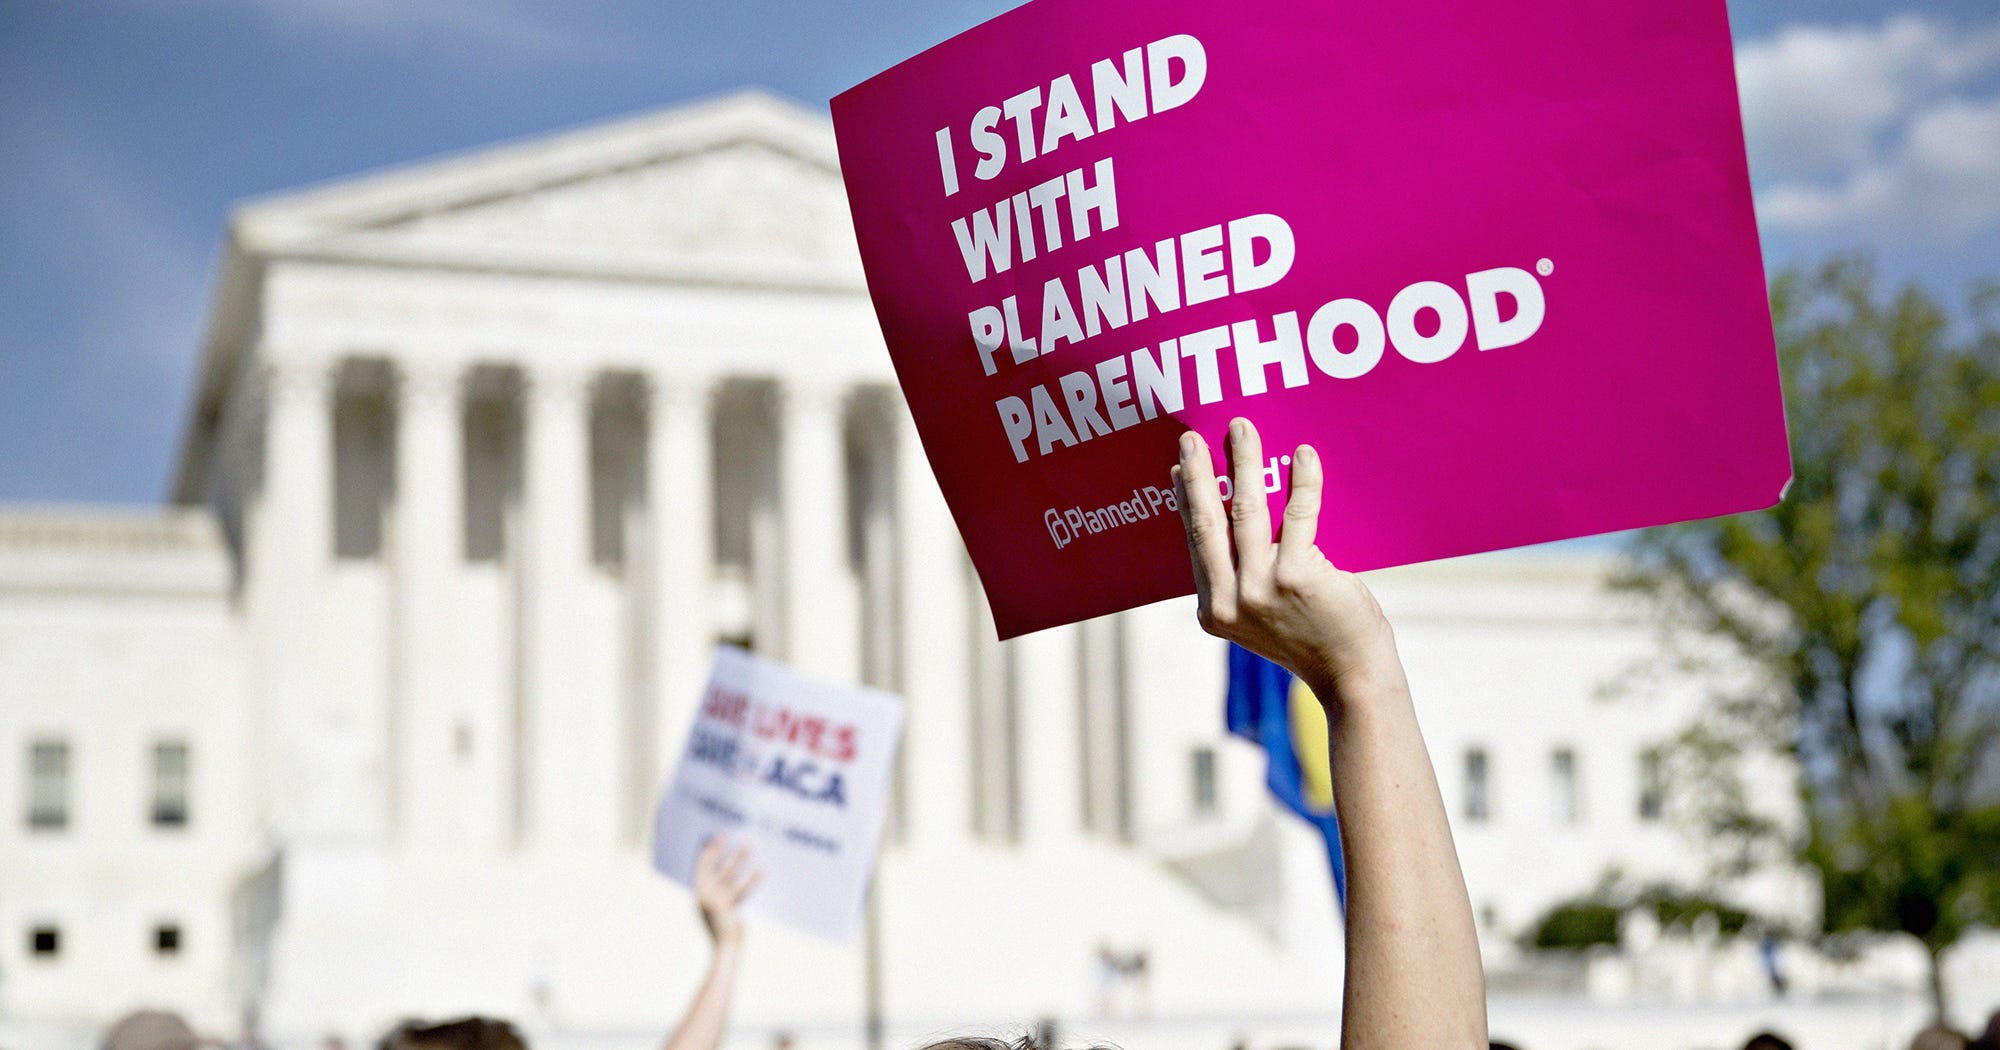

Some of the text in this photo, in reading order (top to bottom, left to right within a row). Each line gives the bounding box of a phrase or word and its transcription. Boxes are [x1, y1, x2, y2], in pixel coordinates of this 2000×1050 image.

[936, 34, 1207, 197] I STAND
[951, 157, 1119, 283] WITH
[968, 214, 1295, 376] PLANNED
[1063, 489, 1150, 538] Planned
